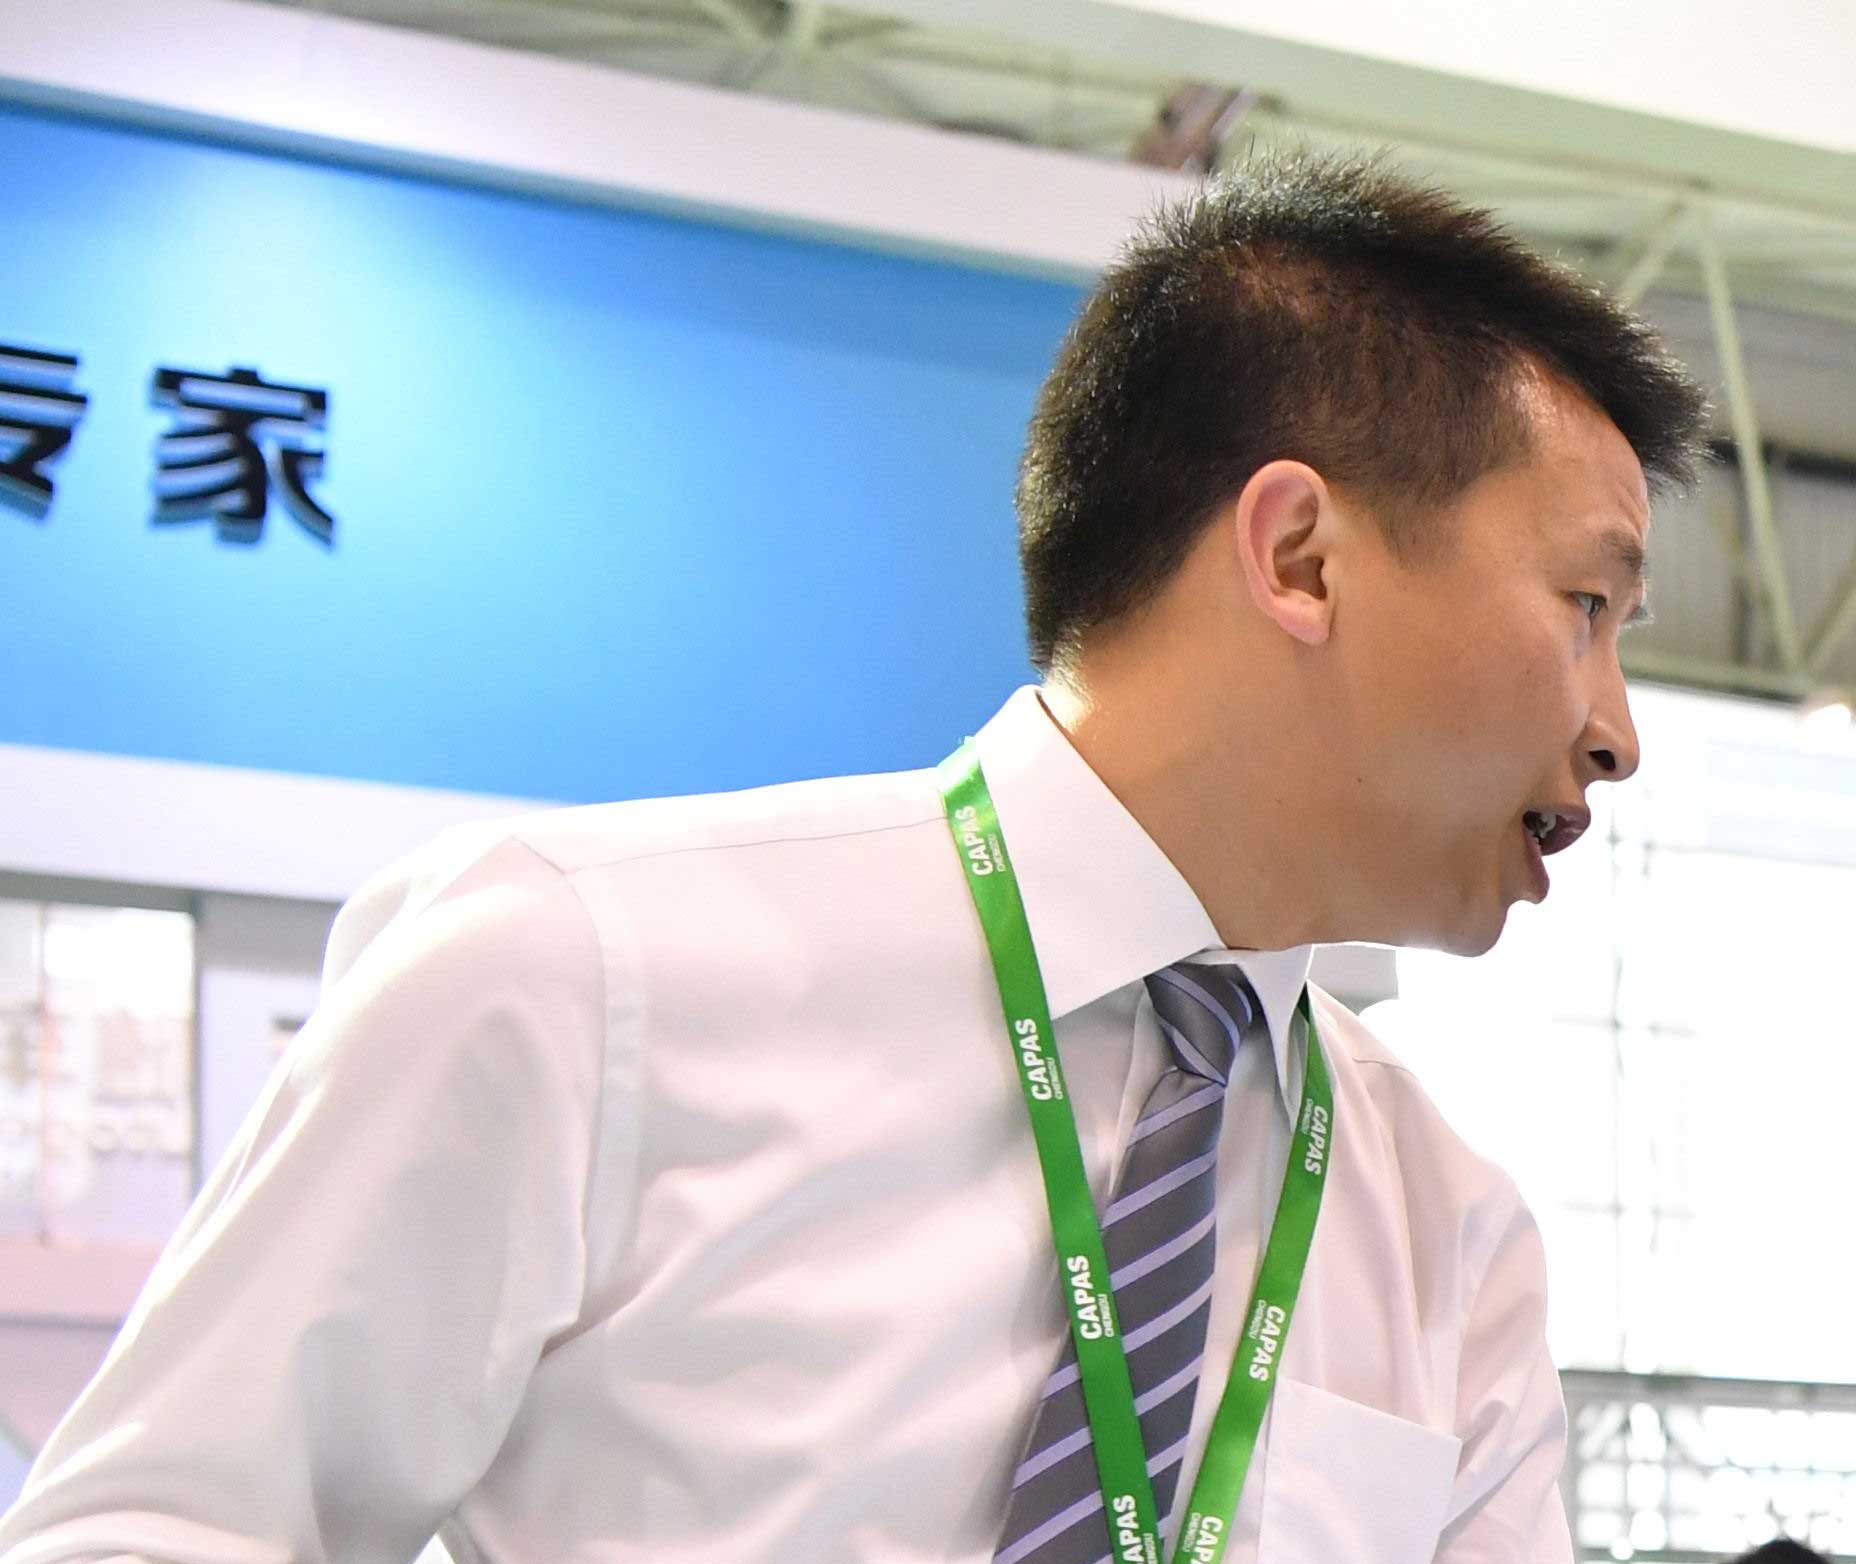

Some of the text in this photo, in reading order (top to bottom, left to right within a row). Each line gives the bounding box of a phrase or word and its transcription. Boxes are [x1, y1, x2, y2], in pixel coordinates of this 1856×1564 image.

[955, 805, 994, 876] CAPAS
[1014, 1018, 1053, 1100] CAPAS
[1304, 1105, 1328, 1175] CAPAS
[1066, 1255, 1103, 1340] CAPAS
[1248, 1305, 1286, 1381] CAPAS
